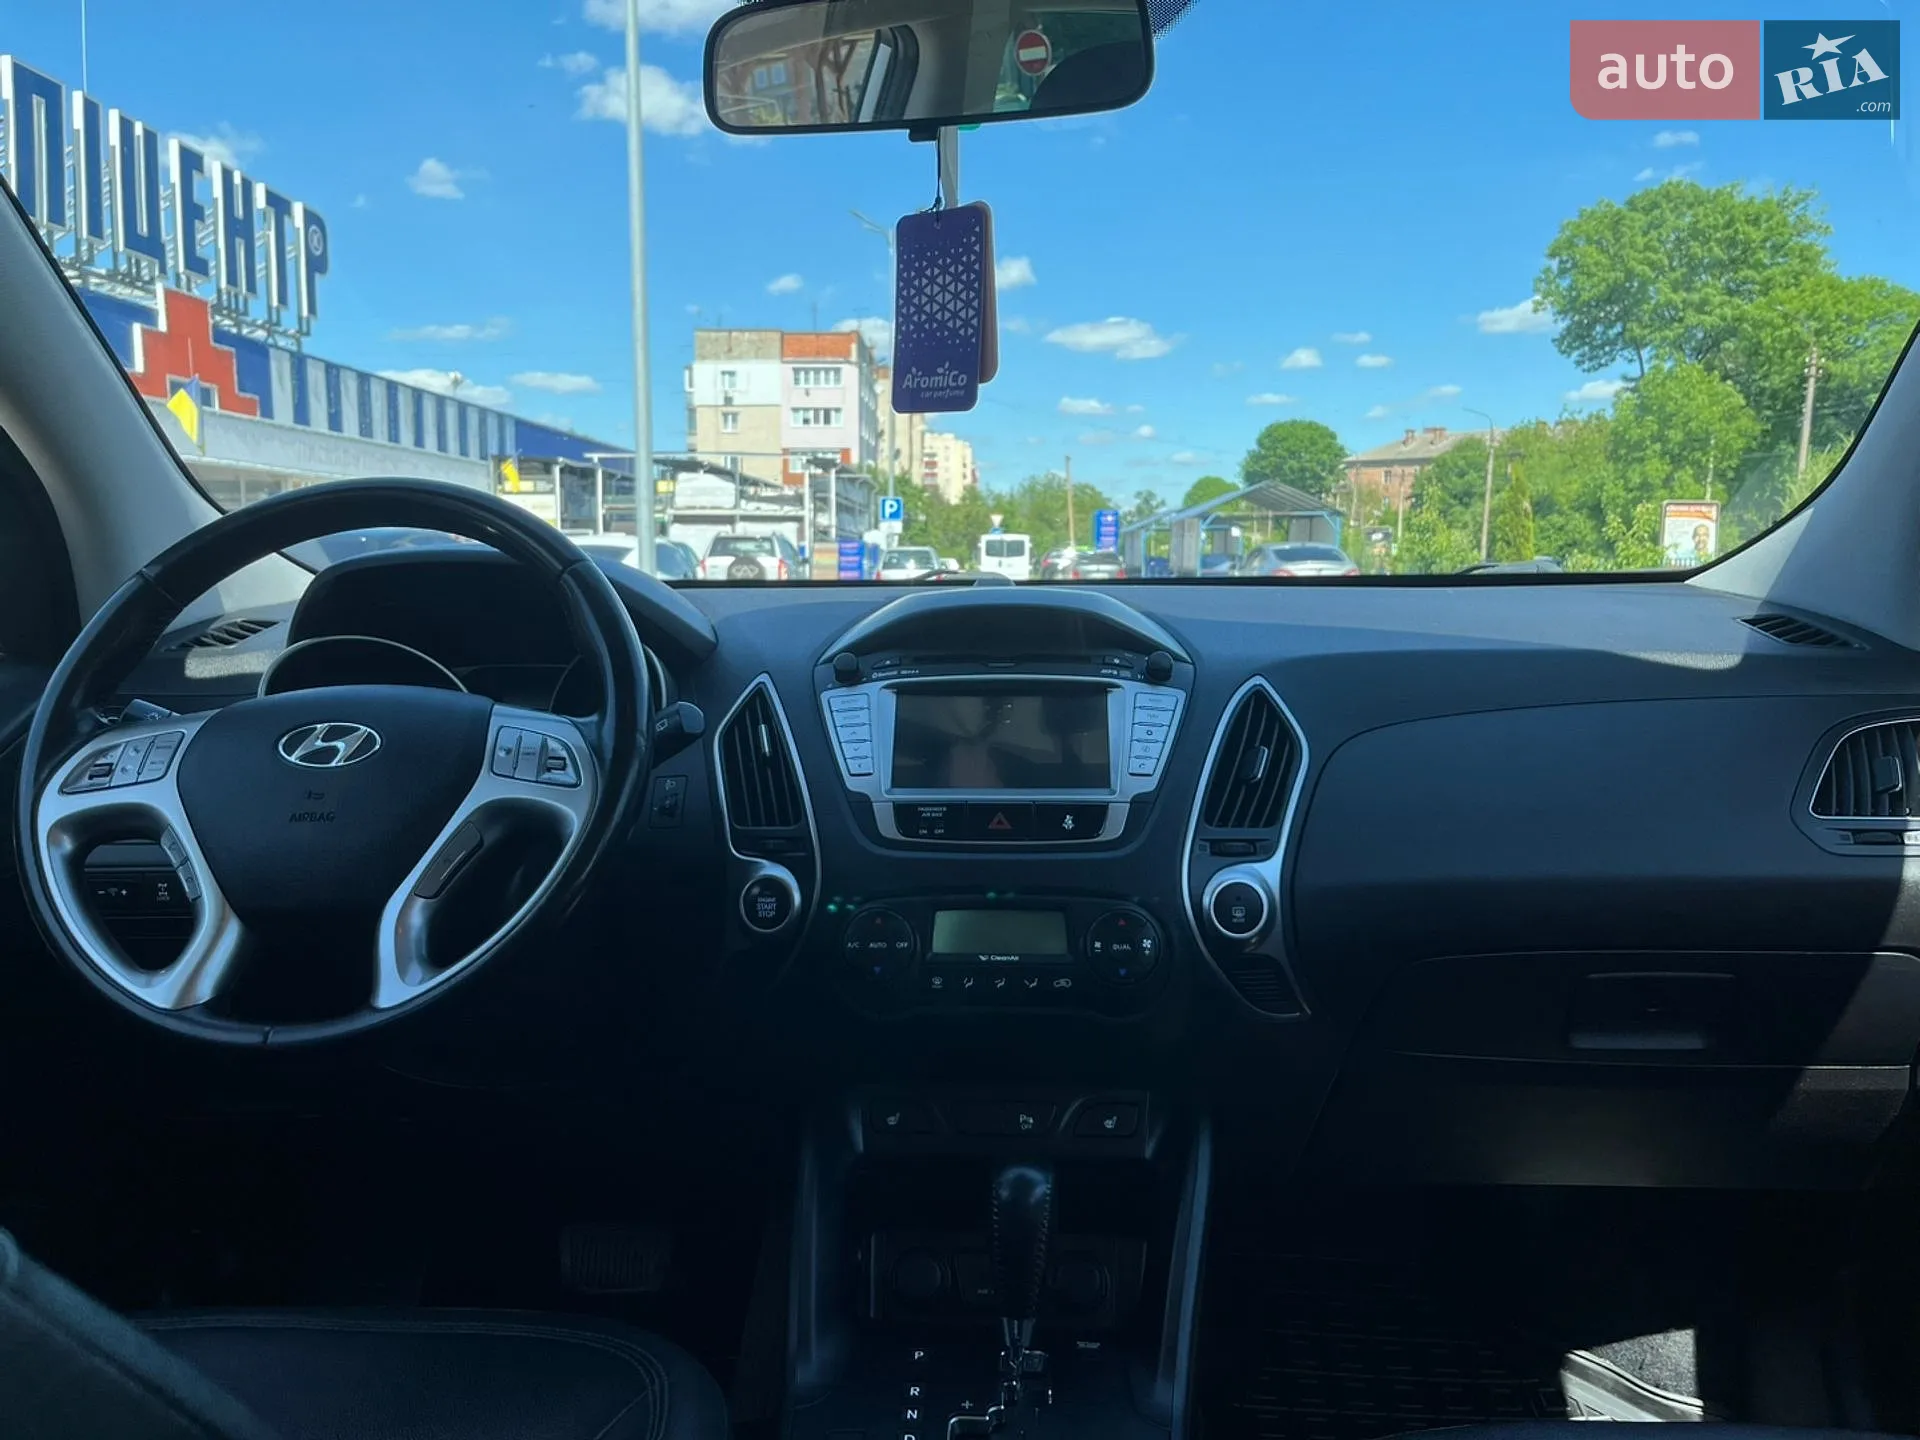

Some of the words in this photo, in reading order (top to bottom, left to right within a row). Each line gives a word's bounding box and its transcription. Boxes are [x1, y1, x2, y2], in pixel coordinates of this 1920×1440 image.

[902, 370, 968, 390] AromiCo
[884, 499, 899, 519] P
[288, 811, 336, 823] AIRBAG
[755, 903, 777, 911] START
[847, 941, 860, 950] A/C
[868, 941, 888, 949] AUTO
[895, 941, 909, 949] OFF
[1112, 943, 1132, 951] DUAL
[914, 1350, 925, 1361] P
[909, 1386, 921, 1397] R
[906, 1409, 918, 1421] N
